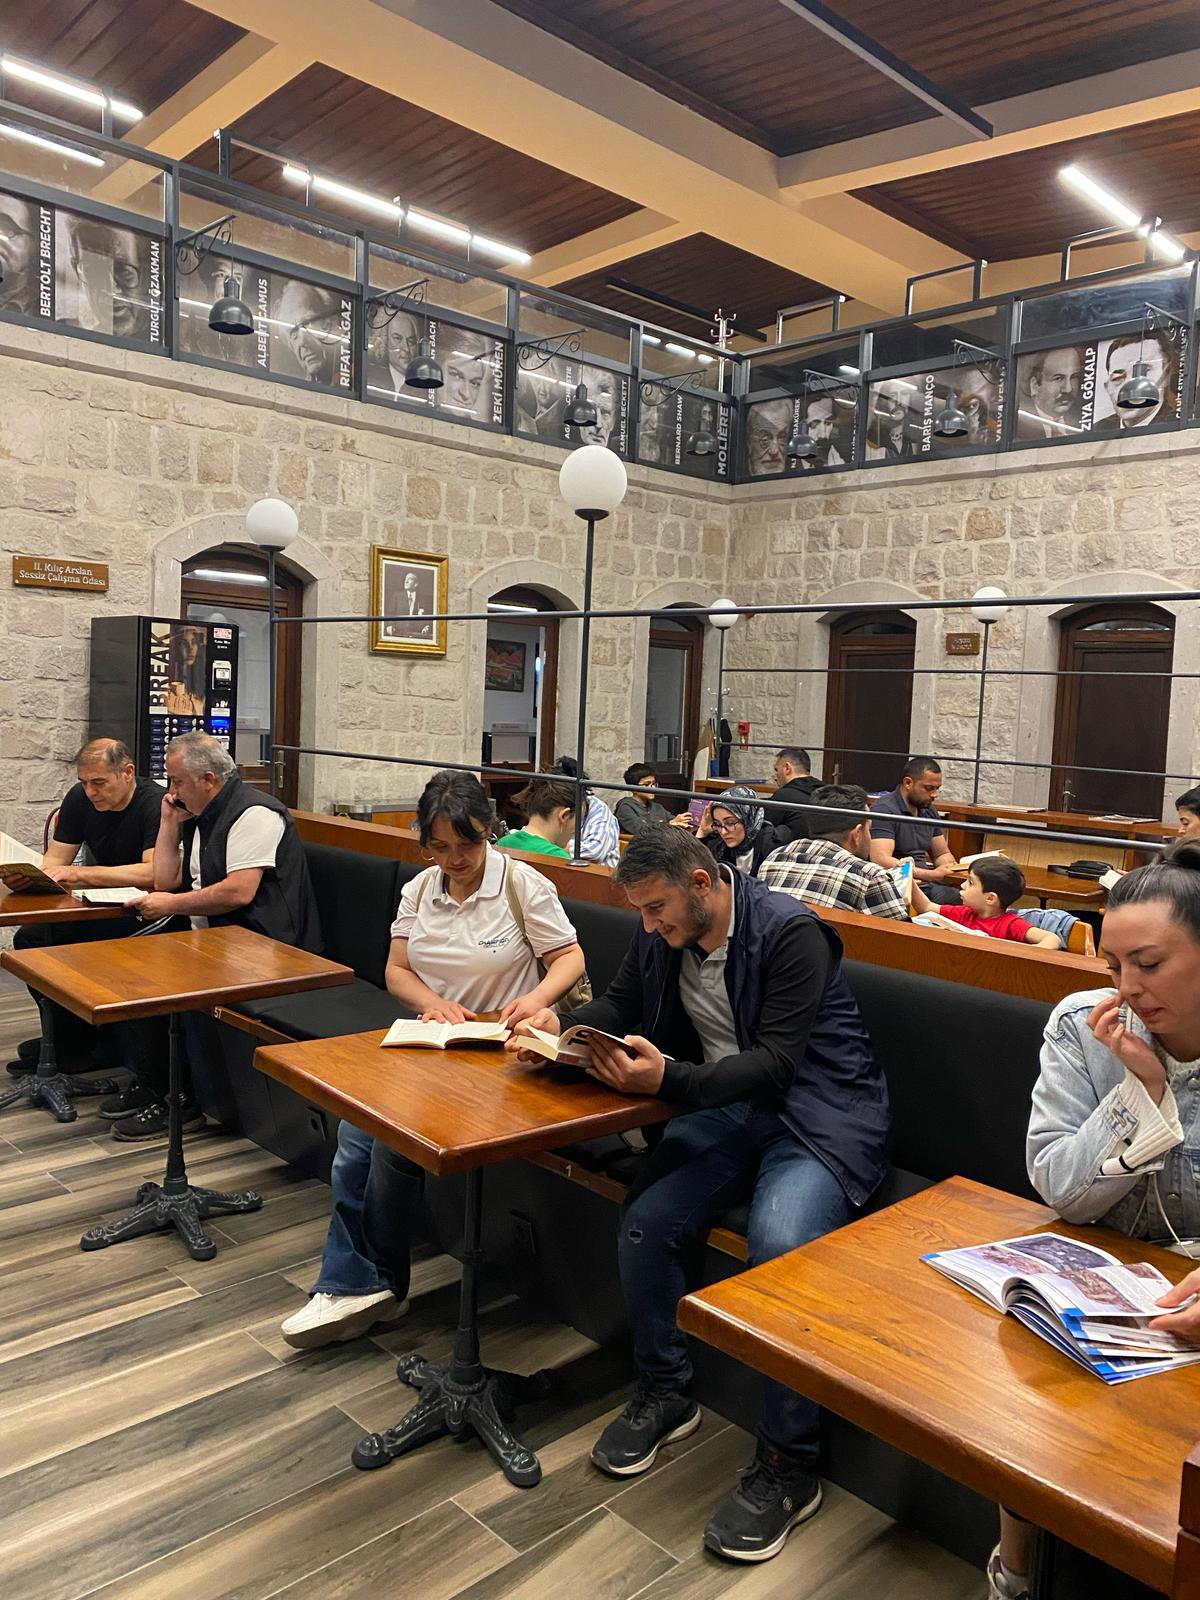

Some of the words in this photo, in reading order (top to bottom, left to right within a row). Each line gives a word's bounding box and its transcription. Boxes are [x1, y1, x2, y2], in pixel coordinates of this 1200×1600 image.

[40, 207, 51, 258] BRECHT
[40, 260, 51, 317] BERTOLT
[150, 298, 159, 342] TURGUT
[340, 346, 350, 387] RIFAT
[492, 341, 504, 390] MÜREN
[1081, 347, 1097, 399] GÖKALP
[492, 391, 502, 424] ZEKİ
[924, 374, 936, 416] MANÇO
[921, 418, 933, 452] BARIŞ
[1079, 402, 1093, 431] ZİYA
[674, 422, 682, 465] BERNARD
[19, 570, 46, 580] Sessiz
[47, 572, 80, 584] Çalışma
[44, 563, 64, 574] Kılıç
[65, 566, 92, 576] Arslan
[150, 632, 171, 707] BREAK
